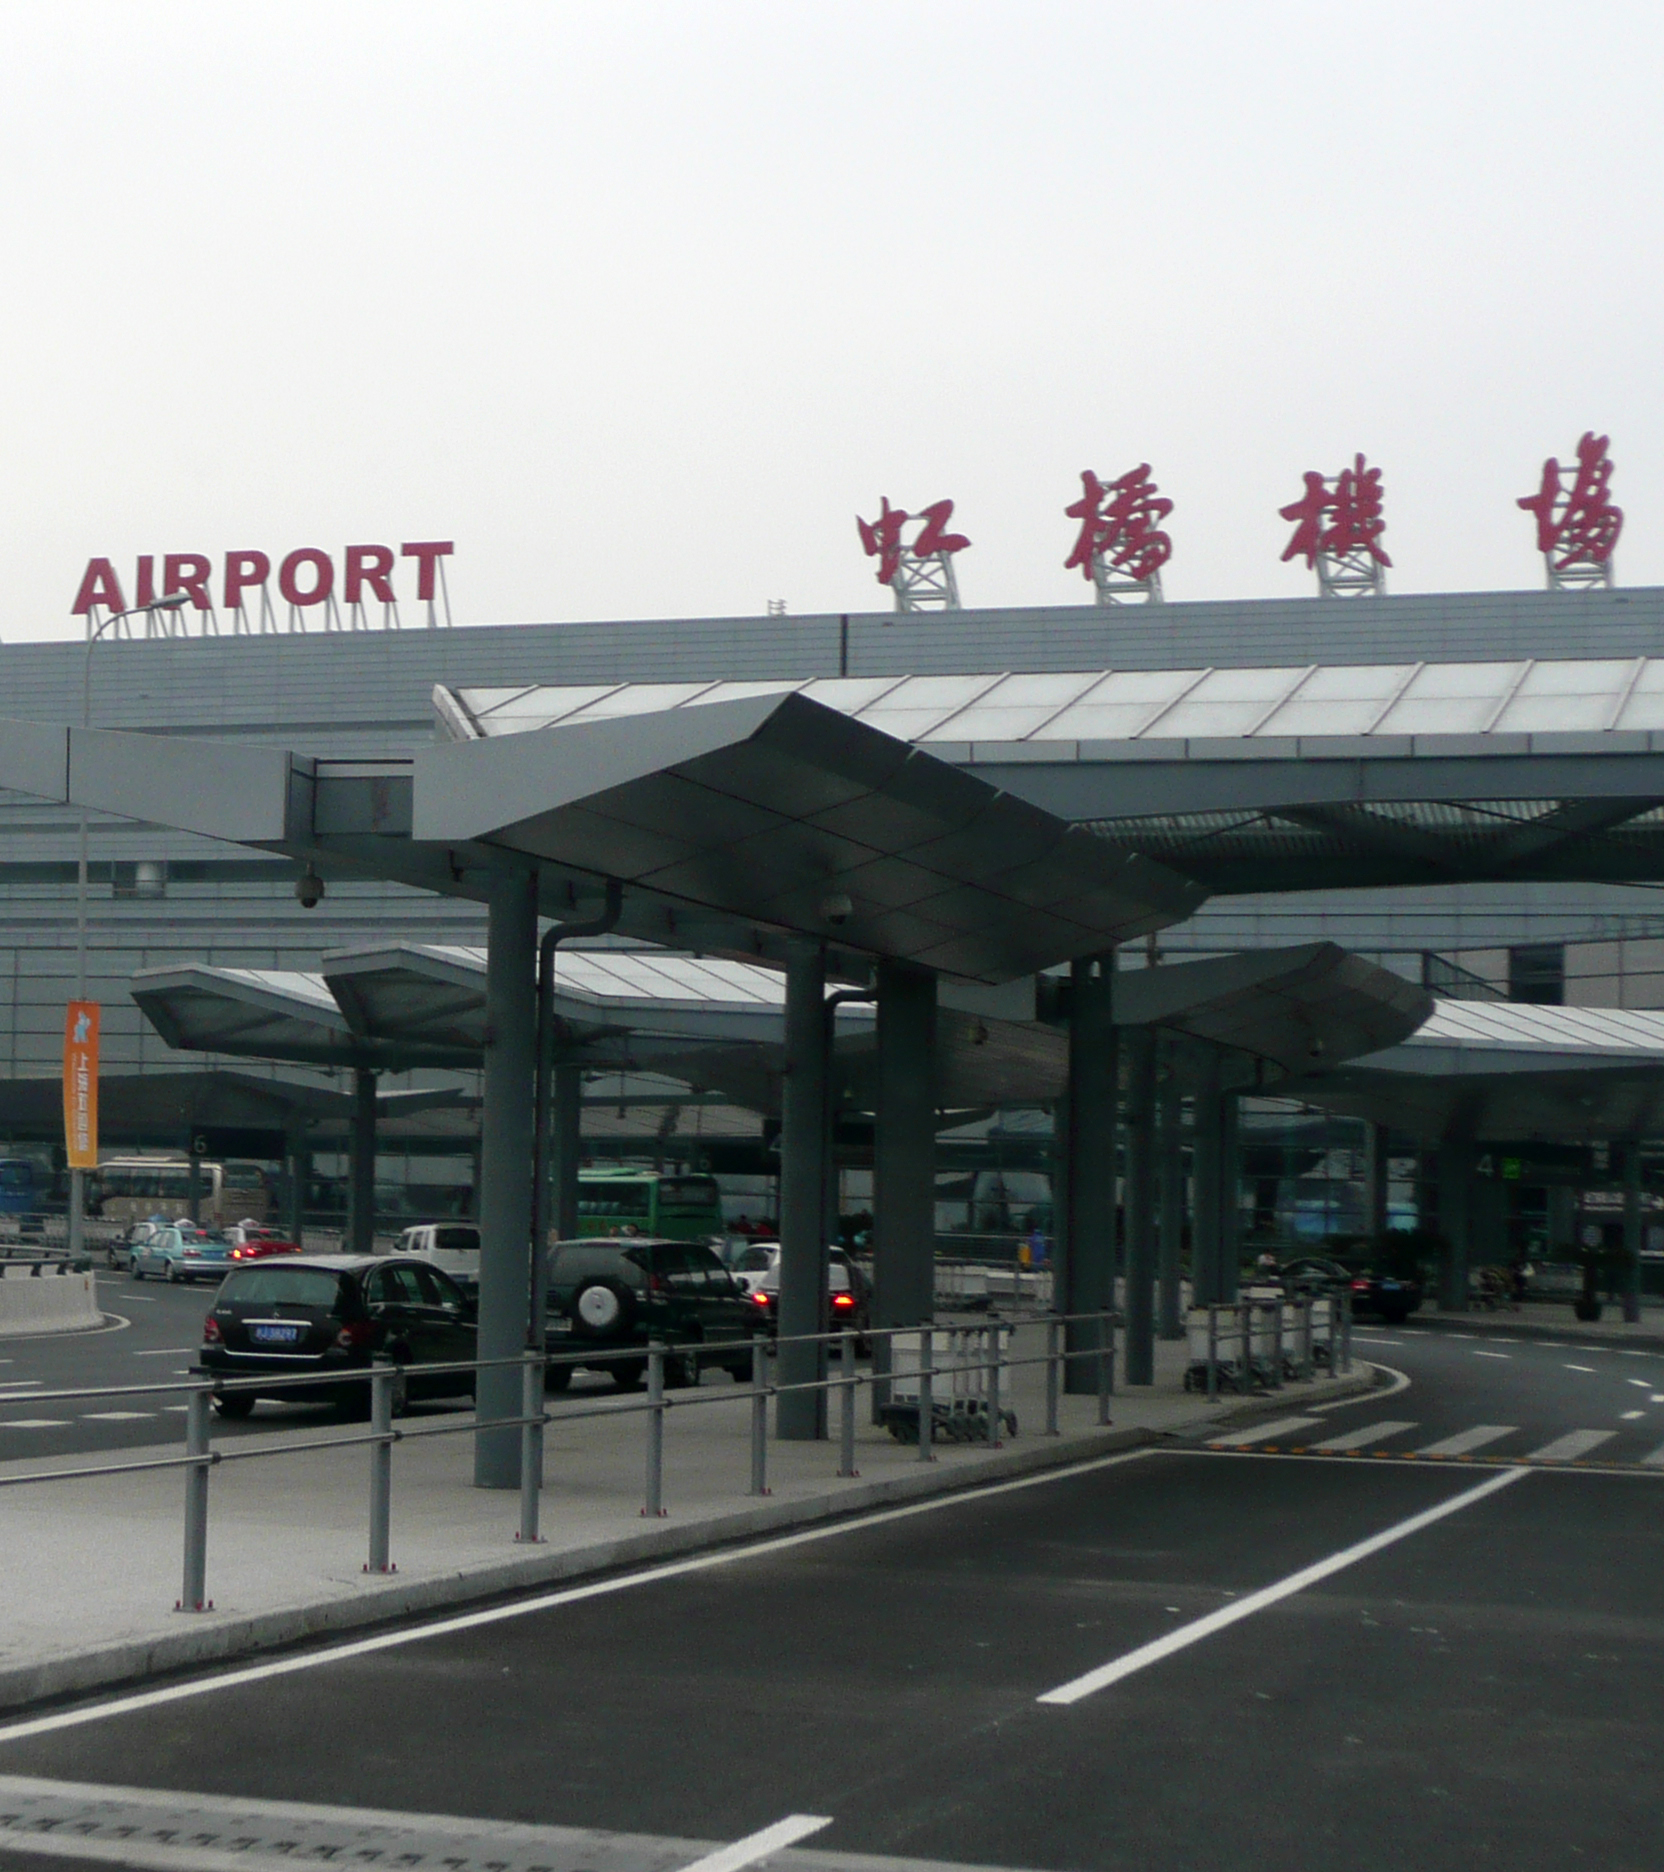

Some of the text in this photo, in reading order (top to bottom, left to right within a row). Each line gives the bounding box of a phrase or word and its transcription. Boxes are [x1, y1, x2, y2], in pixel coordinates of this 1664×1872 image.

[71, 541, 454, 615] AIRPORT
[193, 1134, 207, 1154] 6
[1476, 1153, 1494, 1178] 4
